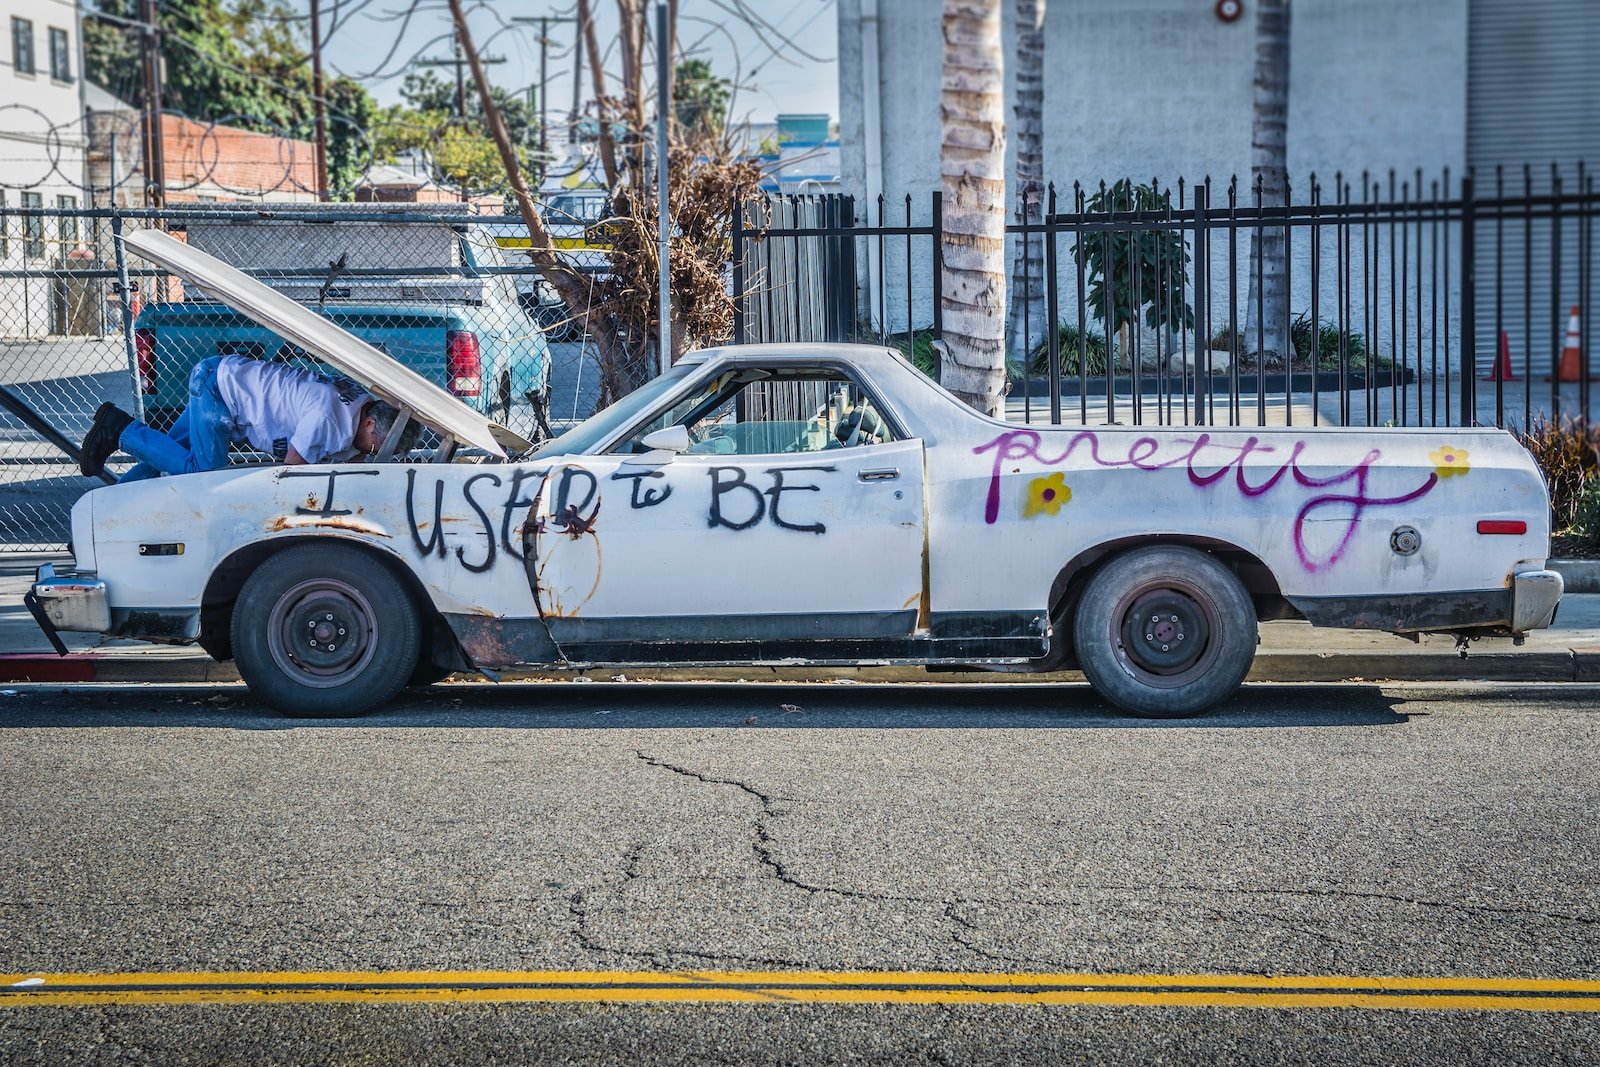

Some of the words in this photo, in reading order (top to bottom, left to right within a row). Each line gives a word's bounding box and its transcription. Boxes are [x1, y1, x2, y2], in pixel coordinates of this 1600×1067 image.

[278, 470, 380, 518] I
[405, 466, 597, 573] USED
[706, 466, 838, 534] BE
[972, 429, 1438, 573] pretty
